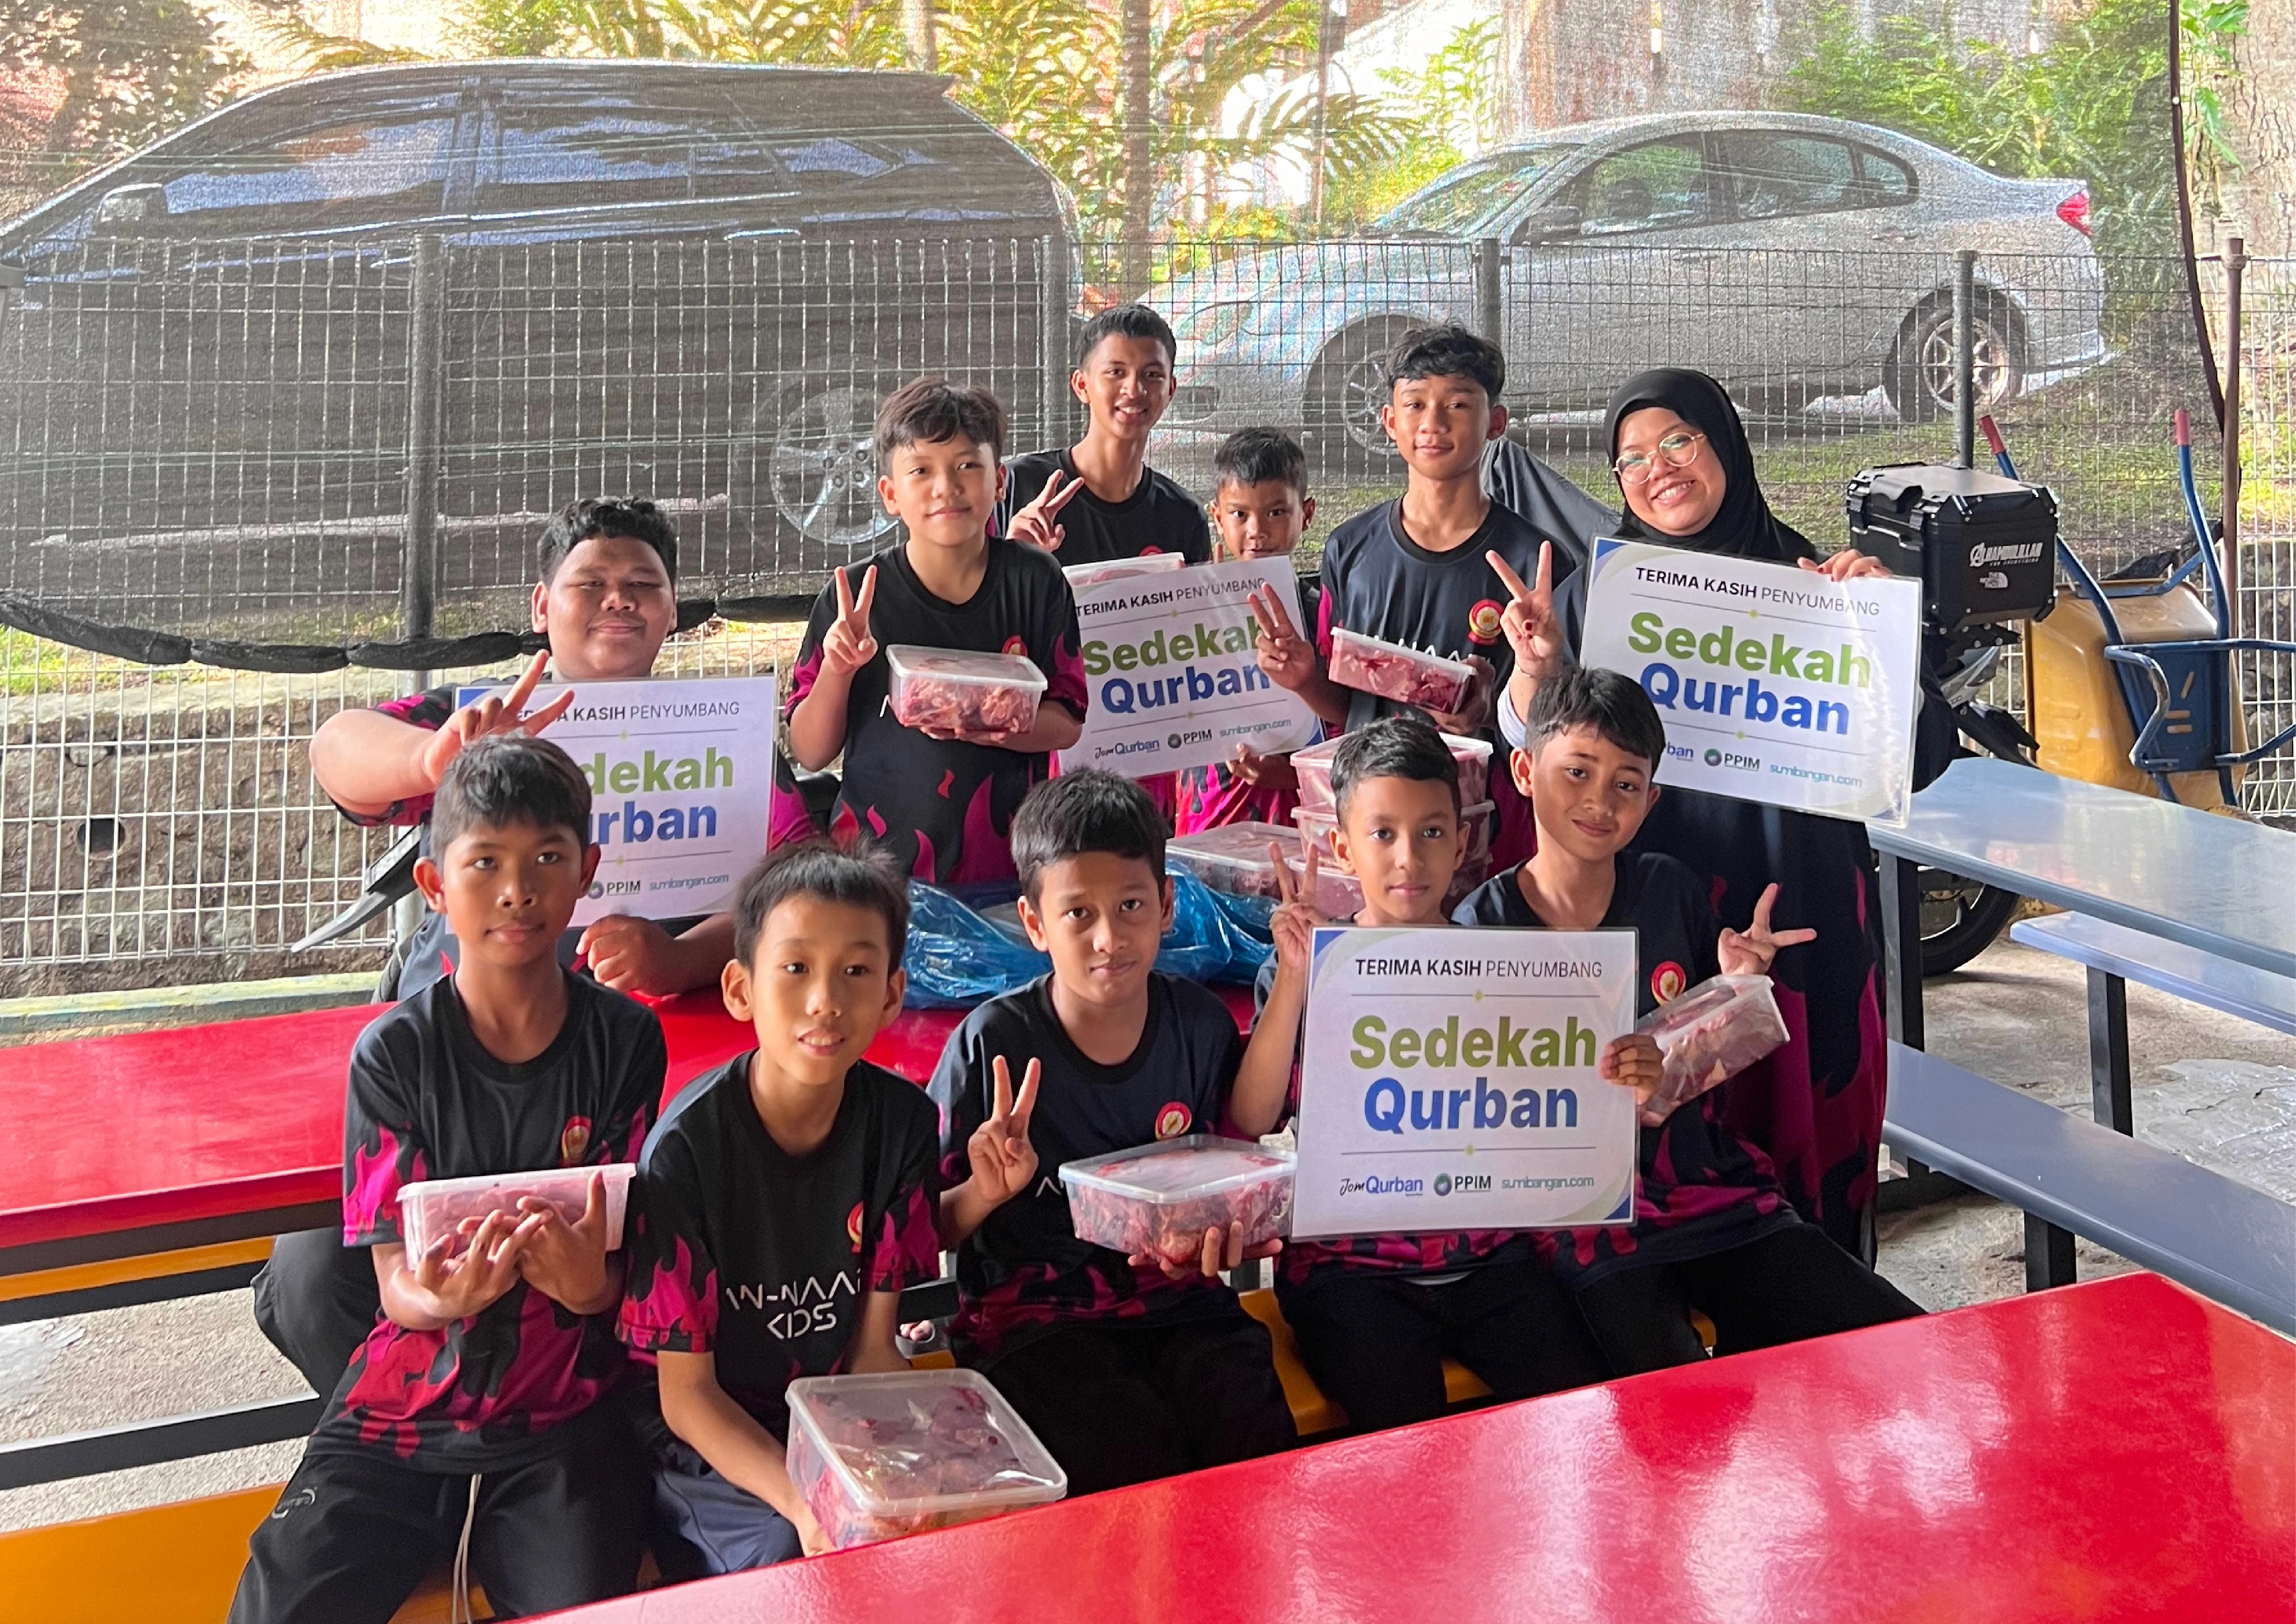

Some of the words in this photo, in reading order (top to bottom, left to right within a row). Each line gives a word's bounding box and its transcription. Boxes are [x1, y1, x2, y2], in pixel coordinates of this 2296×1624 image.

[1076, 598, 1127, 617] TERIMA
[1130, 591, 1173, 609] KASIH
[1635, 567, 1699, 589] TERIMA
[1704, 578, 1757, 599] KASIH
[1761, 587, 1880, 616] PENYUMBANG
[1628, 611, 1871, 688] Sedekah
[573, 706, 626, 721] KASIH
[630, 702, 740, 720] PENYUMBANG
[1101, 664, 1270, 714] Qurban
[1639, 662, 1849, 735] Qurban
[1183, 729, 1213, 743] PPIM
[578, 746, 733, 795] dekah
[1724, 753, 1761, 770] PPIM
[1769, 764, 1862, 787] sumbangan.com
[588, 800, 717, 845] rban
[607, 880, 641, 893] PPIM
[1355, 958, 1422, 975] TERIMA
[1427, 959, 1481, 976] KASIH
[1486, 960, 1602, 977] PENYUMBANG
[1350, 1015, 1596, 1069] Sedekah
[1364, 1077, 1578, 1134] Qurban
[1455, 1175, 1491, 1190] PPIM
[1500, 1175, 1594, 1191] sumbangan.com
